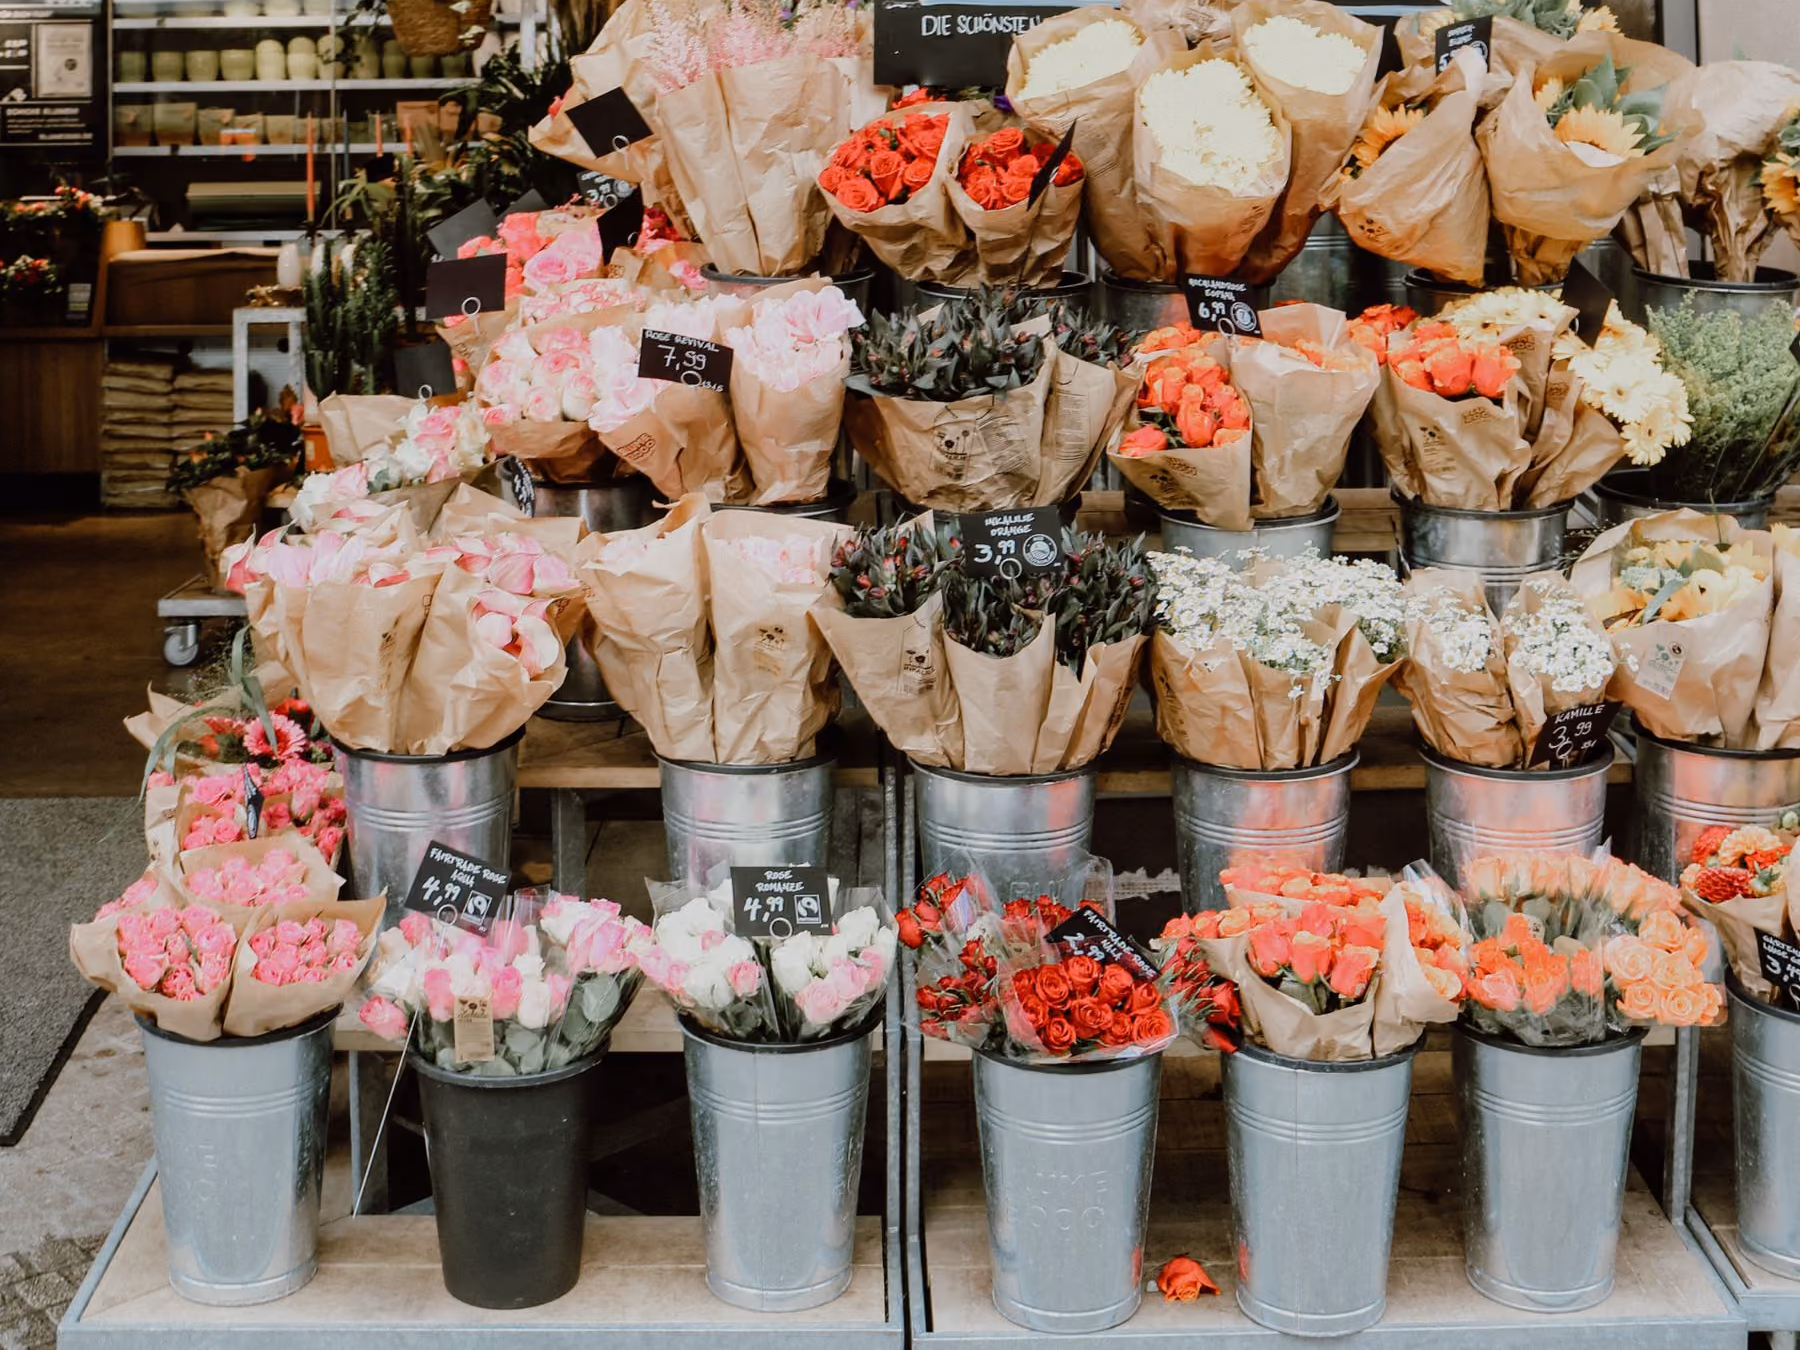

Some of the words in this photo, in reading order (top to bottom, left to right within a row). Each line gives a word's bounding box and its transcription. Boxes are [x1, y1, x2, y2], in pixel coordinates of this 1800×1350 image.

[921, 14, 953, 36] DIE
[1197, 301, 1226, 323] 6,99
[645, 329, 672, 342] ROSE
[990, 523, 1033, 538] ORANGE
[973, 539, 1016, 566] 3,99
[1554, 704, 1606, 725] KAMILLE
[430, 847, 482, 875] FAIRTRADE
[482, 868, 508, 885] ROSE
[763, 869, 794, 881] ROSE
[421, 875, 462, 907] 4,99
[743, 896, 785, 923] 4,99
[1083, 909, 1135, 955] FAIRTRADE
[1132, 953, 1158, 980] ROSE
[1100, 938, 1123, 962] NALA
